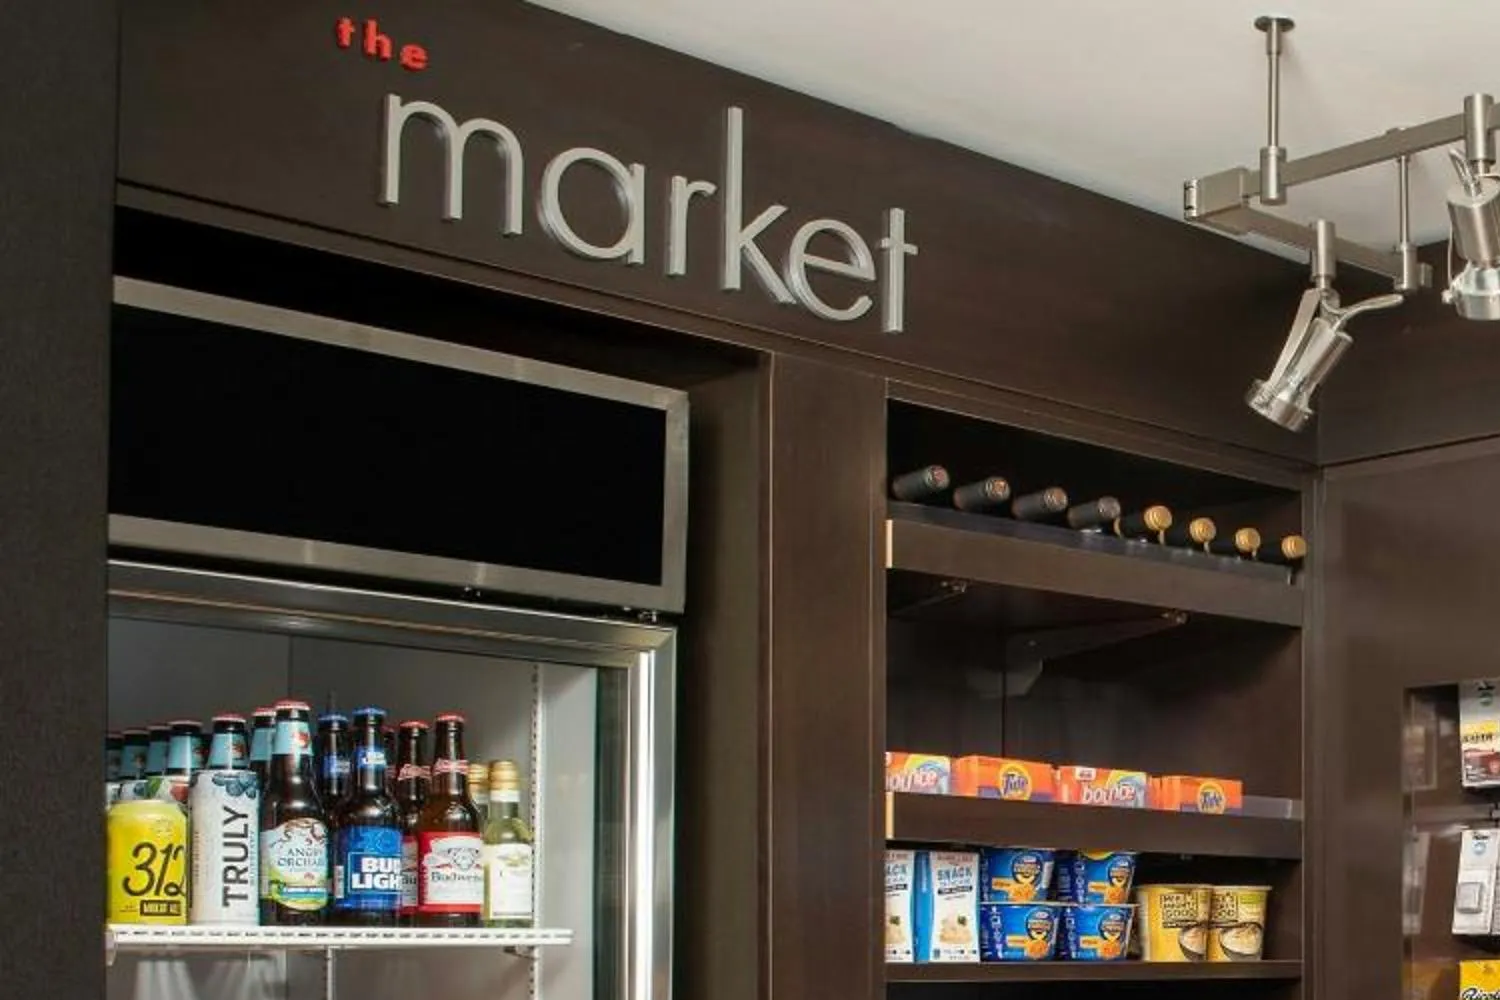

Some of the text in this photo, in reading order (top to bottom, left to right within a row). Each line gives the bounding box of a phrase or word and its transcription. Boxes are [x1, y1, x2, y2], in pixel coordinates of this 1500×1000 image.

[336, 16, 429, 71] the
[378, 92, 919, 334] market
[222, 805, 249, 908] TRULY
[352, 873, 404, 890] LIGH
